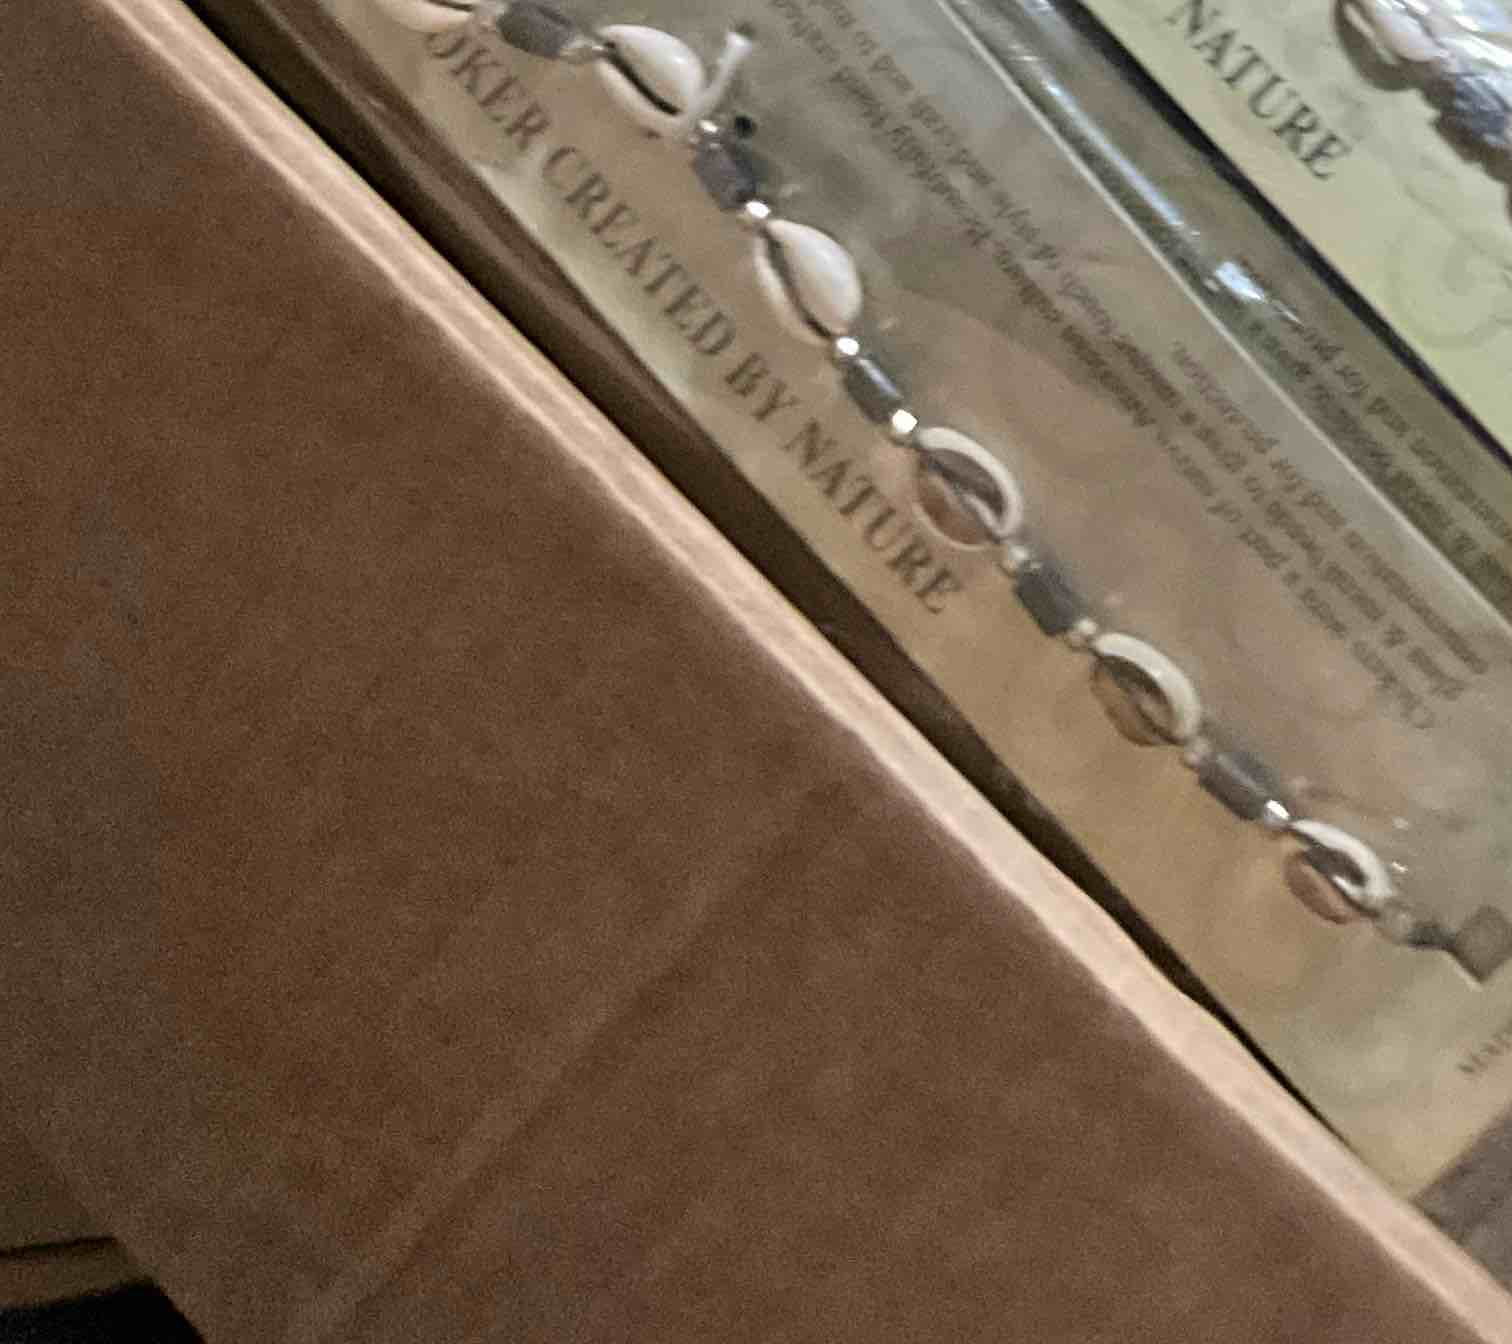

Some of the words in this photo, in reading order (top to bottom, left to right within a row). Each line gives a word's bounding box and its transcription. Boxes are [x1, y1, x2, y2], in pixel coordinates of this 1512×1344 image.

[424, 24, 552, 150] OKER
[541, 146, 736, 357] CREATED
[725, 352, 795, 423] BY
[784, 416, 963, 614] NATURE
